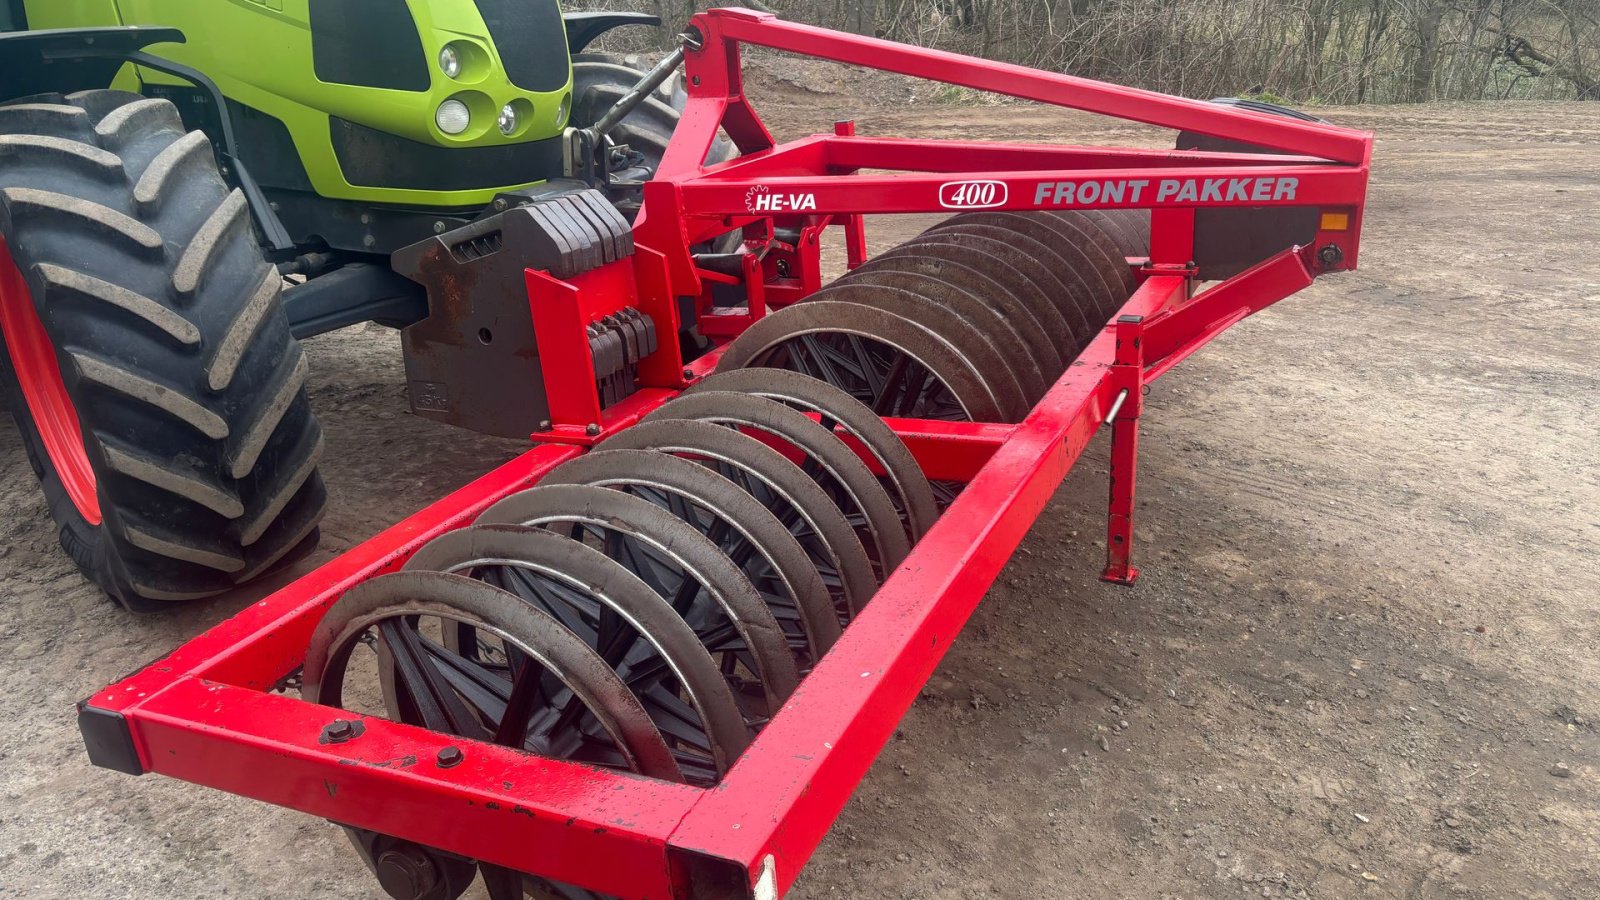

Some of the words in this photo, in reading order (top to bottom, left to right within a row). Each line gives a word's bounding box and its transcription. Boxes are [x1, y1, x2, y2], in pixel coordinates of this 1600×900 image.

[755, 193, 817, 211] HE-VA
[951, 183, 996, 205] 400
[1033, 179, 1150, 205] FRONT
[1156, 177, 1299, 202] PAKKER
